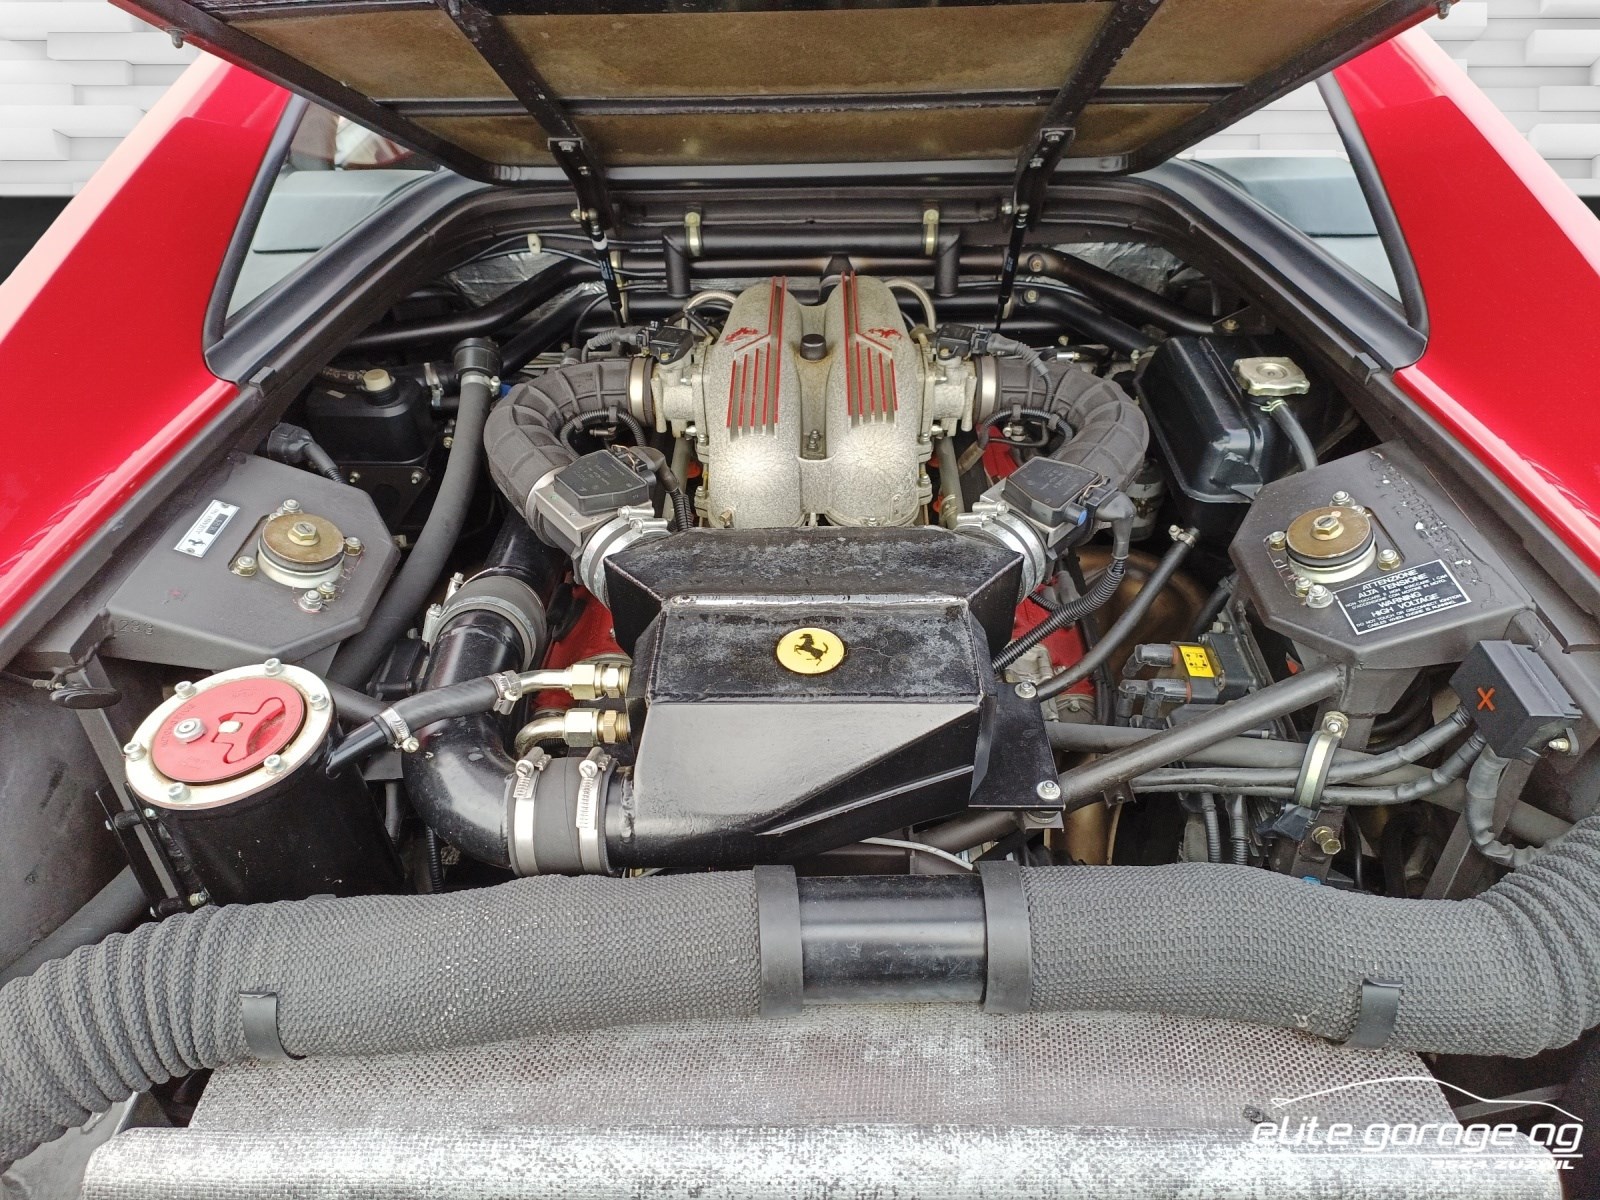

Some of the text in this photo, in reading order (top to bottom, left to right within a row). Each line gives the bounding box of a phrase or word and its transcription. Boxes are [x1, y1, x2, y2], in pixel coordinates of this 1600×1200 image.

[1358, 572, 1428, 599] ALTA TENSIONE
[1362, 570, 1418, 591] ATTENZIONE
[1370, 592, 1440, 618] HIGH VOLTAGE
[1378, 591, 1422, 608] WARNING
[1377, 613, 1395, 621] TOUCH
